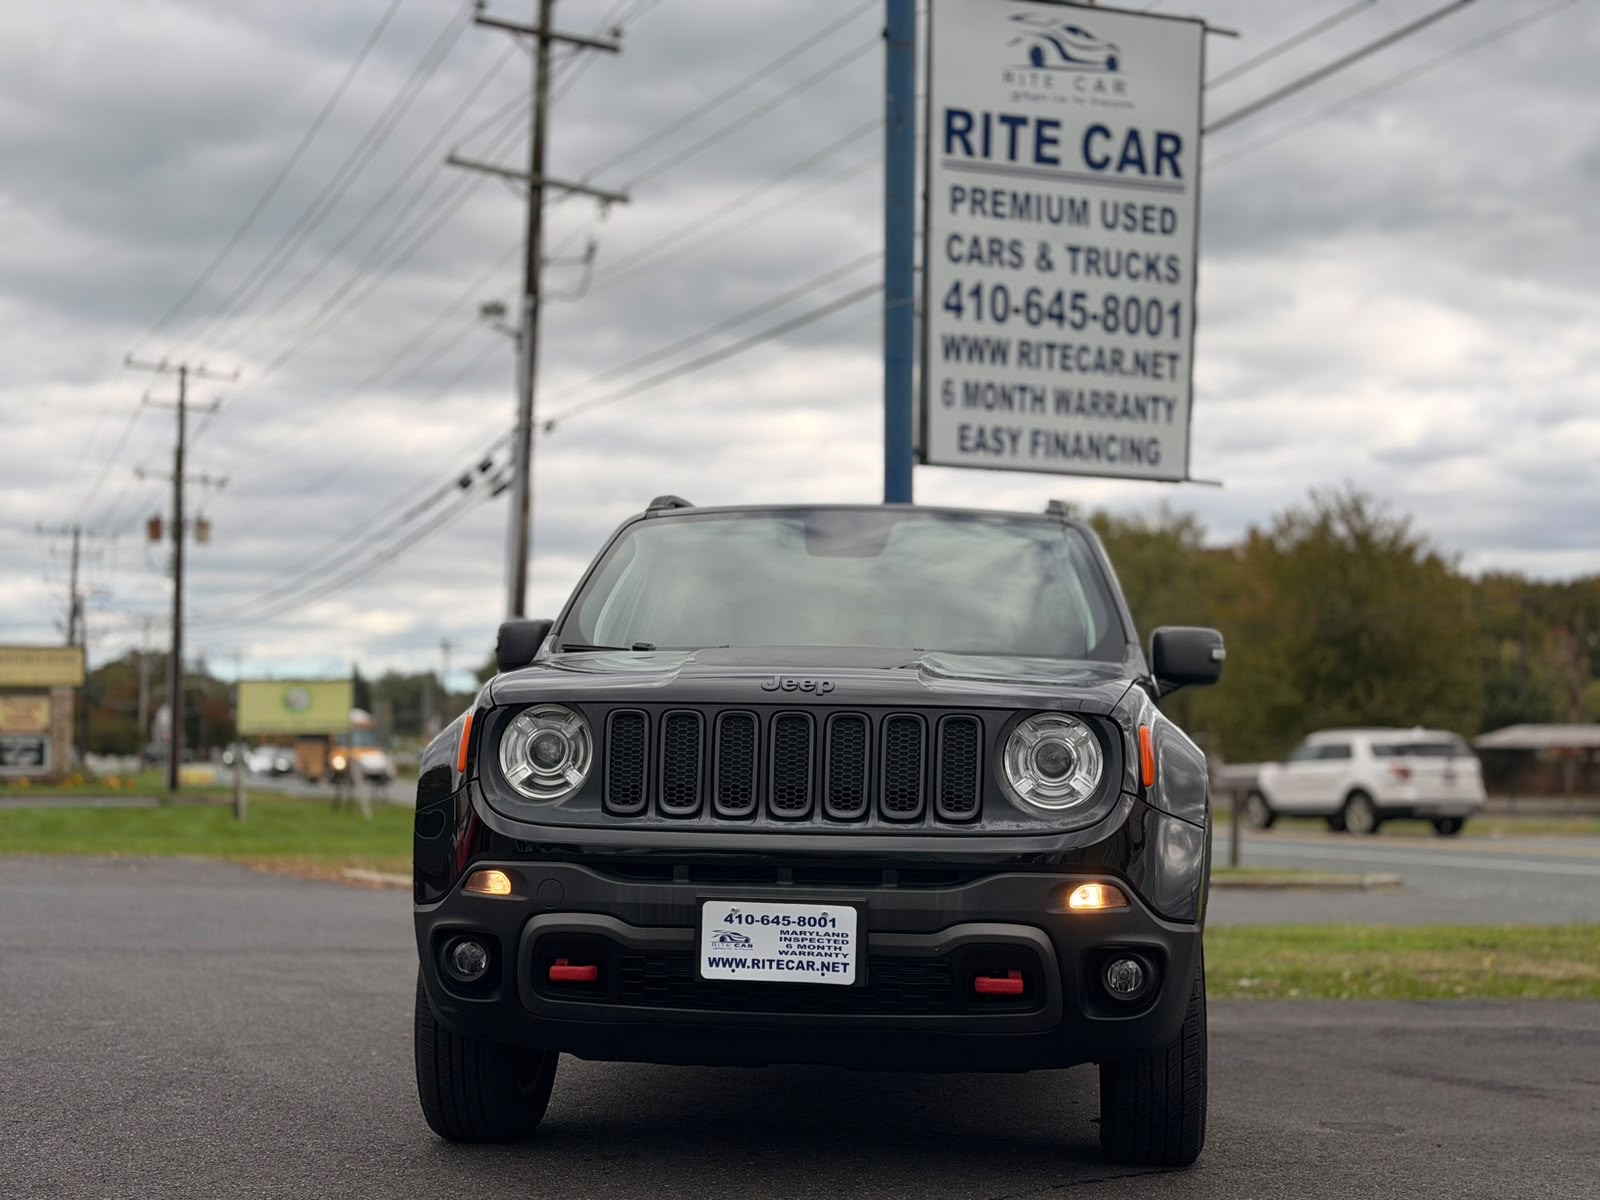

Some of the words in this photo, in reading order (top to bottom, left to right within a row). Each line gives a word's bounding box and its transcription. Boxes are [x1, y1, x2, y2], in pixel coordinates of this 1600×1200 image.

[1002, 70, 1054, 90] RITE
[1072, 75, 1128, 97] CAR
[945, 108, 1061, 166] RITE
[1083, 124, 1183, 179] CAR
[950, 184, 1089, 227] PREMIUM
[1101, 202, 1178, 236] USED
[945, 234, 1024, 271] CARS
[1035, 242, 1054, 273] &
[1066, 244, 1182, 285] TRUCKS
[942, 280, 1182, 340] 410-645-8001
[941, 379, 955, 408] 6
[963, 380, 1046, 414] MONTH
[1053, 391, 1178, 424] WARRANTY
[957, 423, 1022, 456] EASY
[1030, 429, 1162, 466] FINANCING
[761, 674, 835, 696] Jeep
[724, 914, 836, 928] 410-645-8001
[779, 930, 849, 938] MARYLAND
[778, 950, 849, 959] WARRANTY
[779, 937, 849, 945] INSPECTED
[708, 957, 850, 973] WWW.RITECAR.NET
